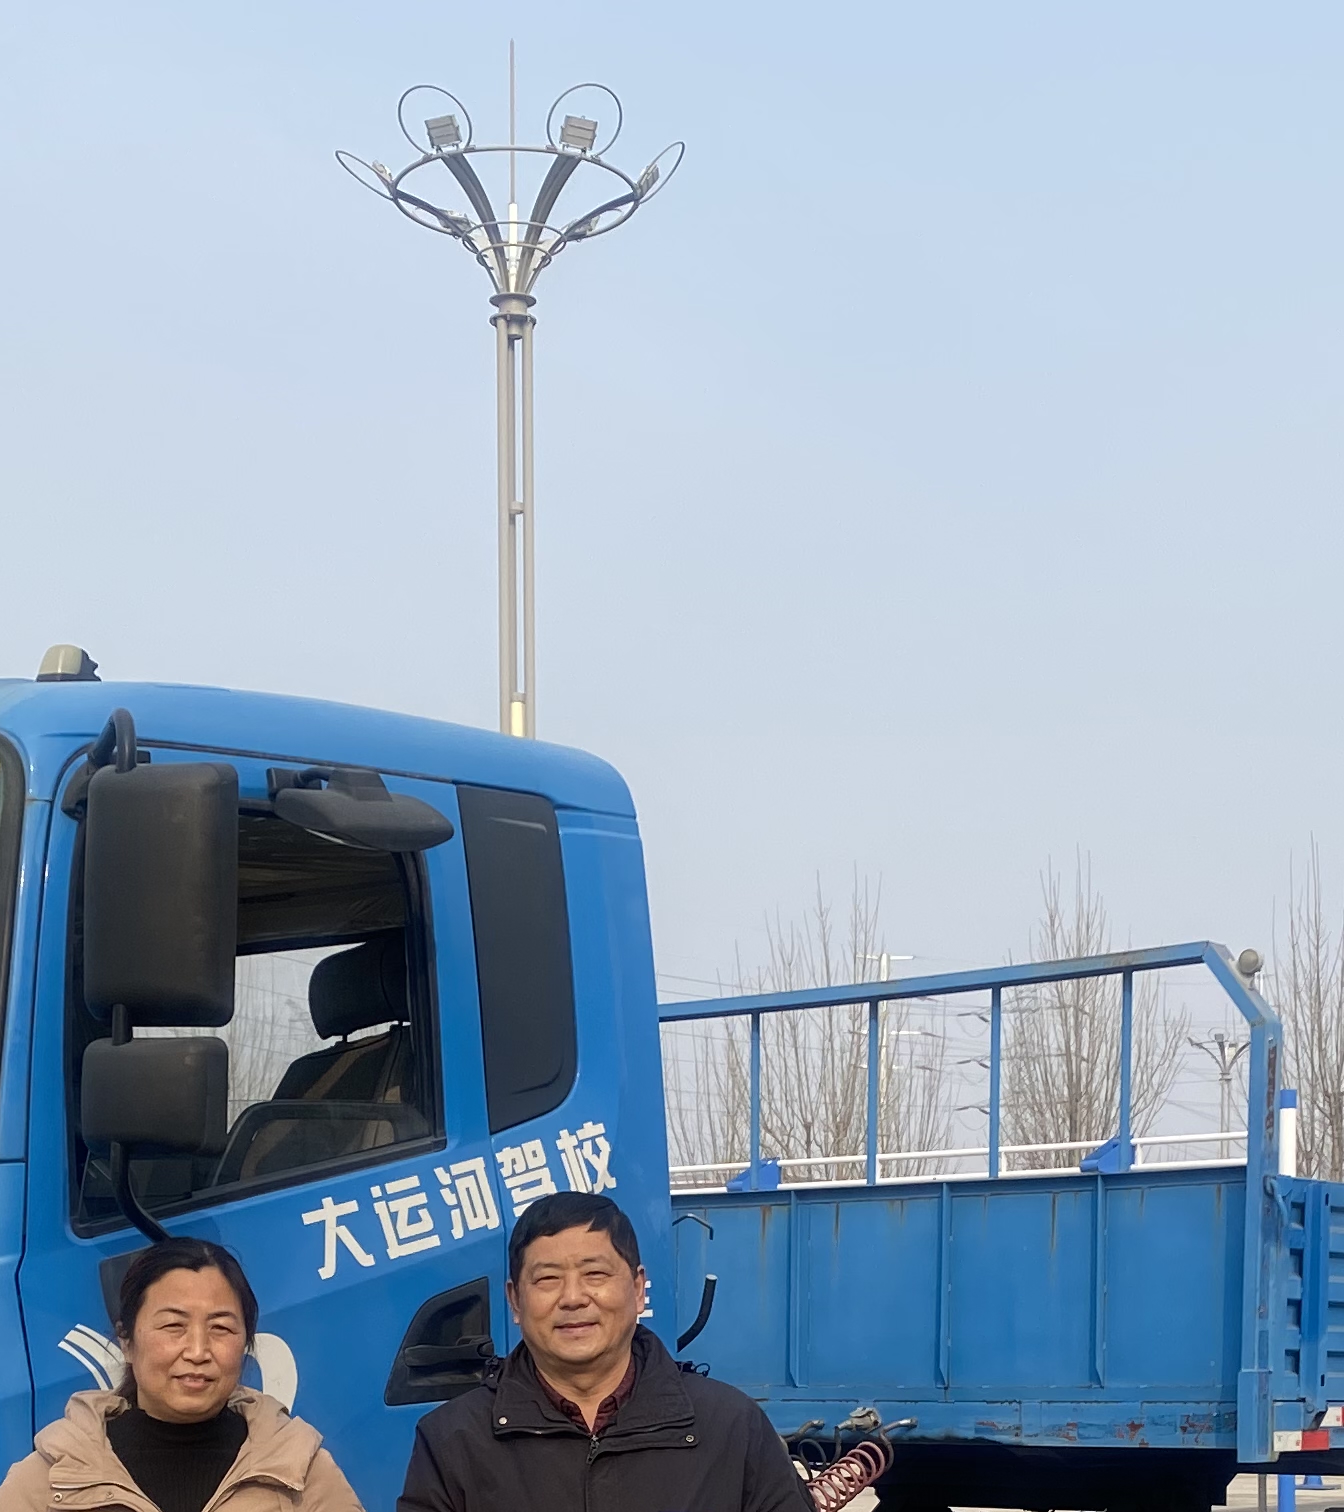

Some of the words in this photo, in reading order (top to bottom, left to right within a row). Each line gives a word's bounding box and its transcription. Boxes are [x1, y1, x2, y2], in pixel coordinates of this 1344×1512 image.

[301, 1121, 617, 1281] 大运河驾校
